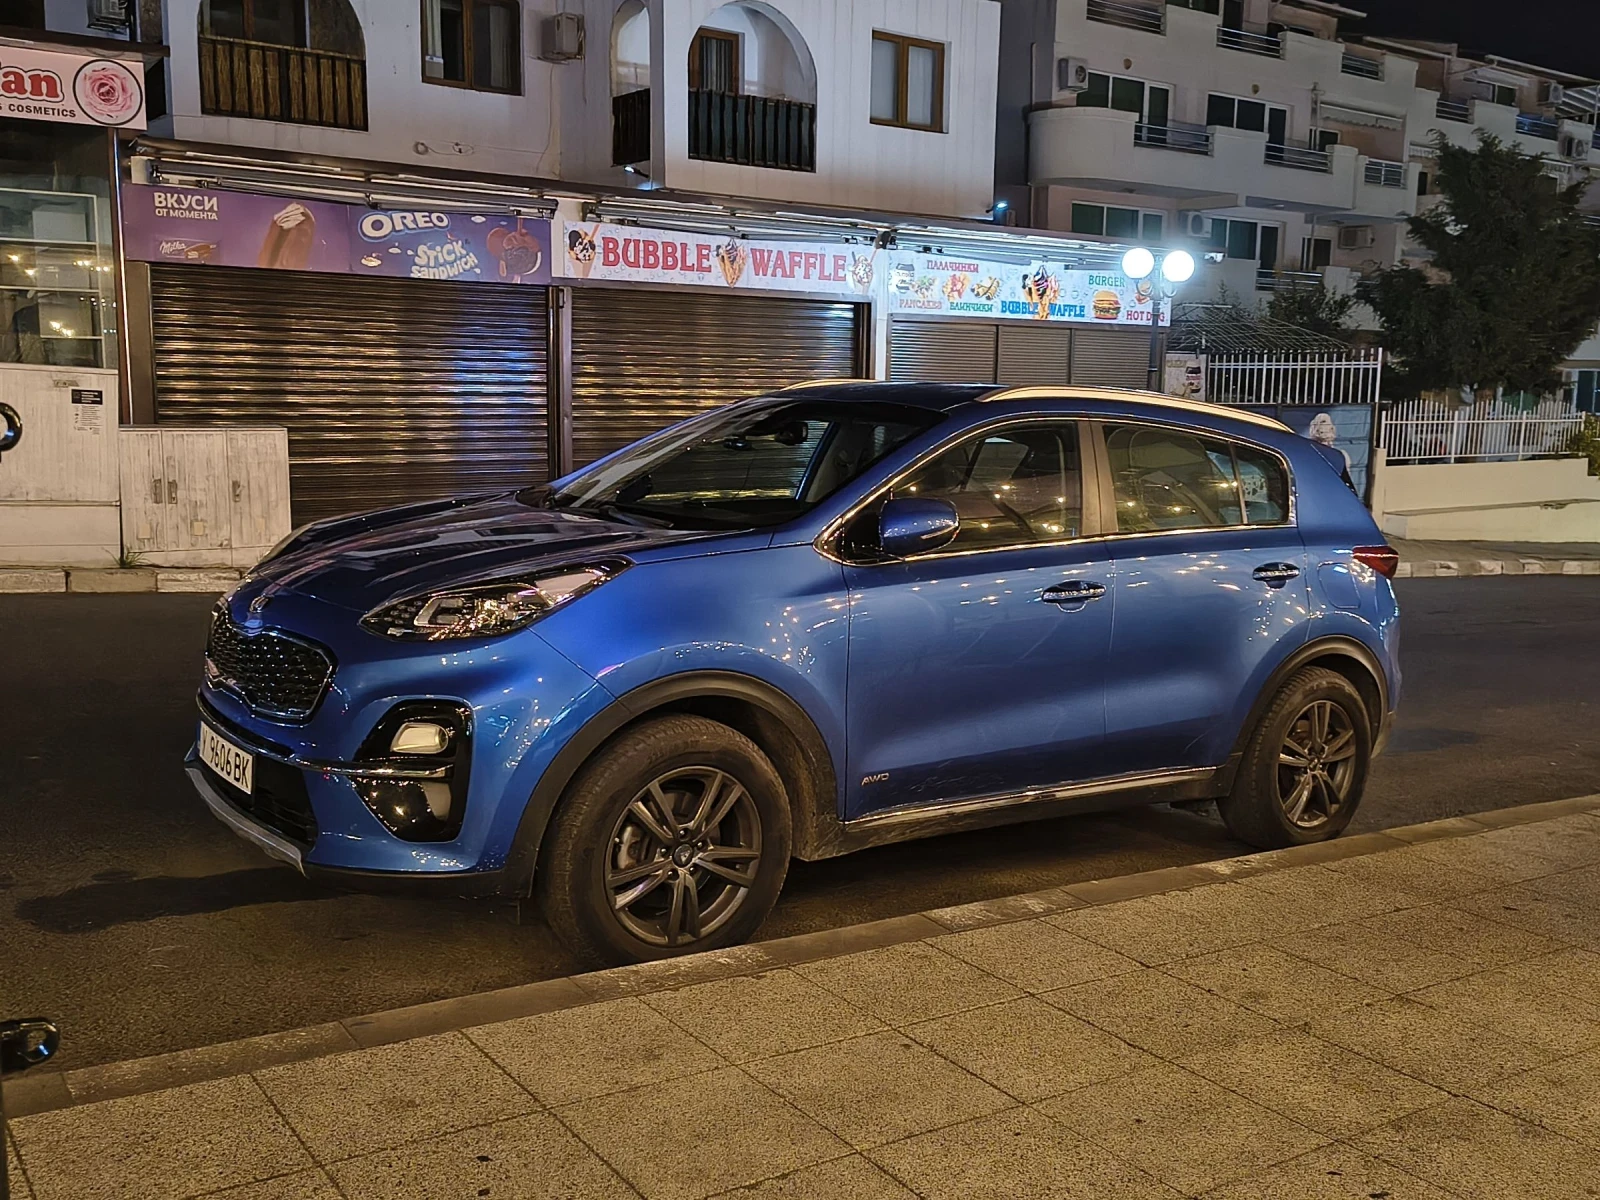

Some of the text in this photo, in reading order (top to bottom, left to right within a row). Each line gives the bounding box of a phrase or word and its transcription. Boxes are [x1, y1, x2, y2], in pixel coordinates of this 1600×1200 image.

[8, 103, 77, 118] COSMETICS
[153, 192, 218, 211] ВКУСИ
[155, 208, 218, 220] ОТ МОМЕНТА
[361, 211, 449, 238] OREO
[160, 240, 187, 254] Milka
[601, 236, 847, 281] BUBBLE WAFFLE
[927, 260, 979, 273] ПАЛАЧИНКИ
[1088, 275, 1125, 287] BURGER
[1001, 301, 1085, 317] BUBBLE WAFFLE
[1126, 310, 1165, 322] HOT DG
[210, 735, 232, 777] 9606
[234, 751, 250, 789] BK
[861, 772, 890, 786] AWD
